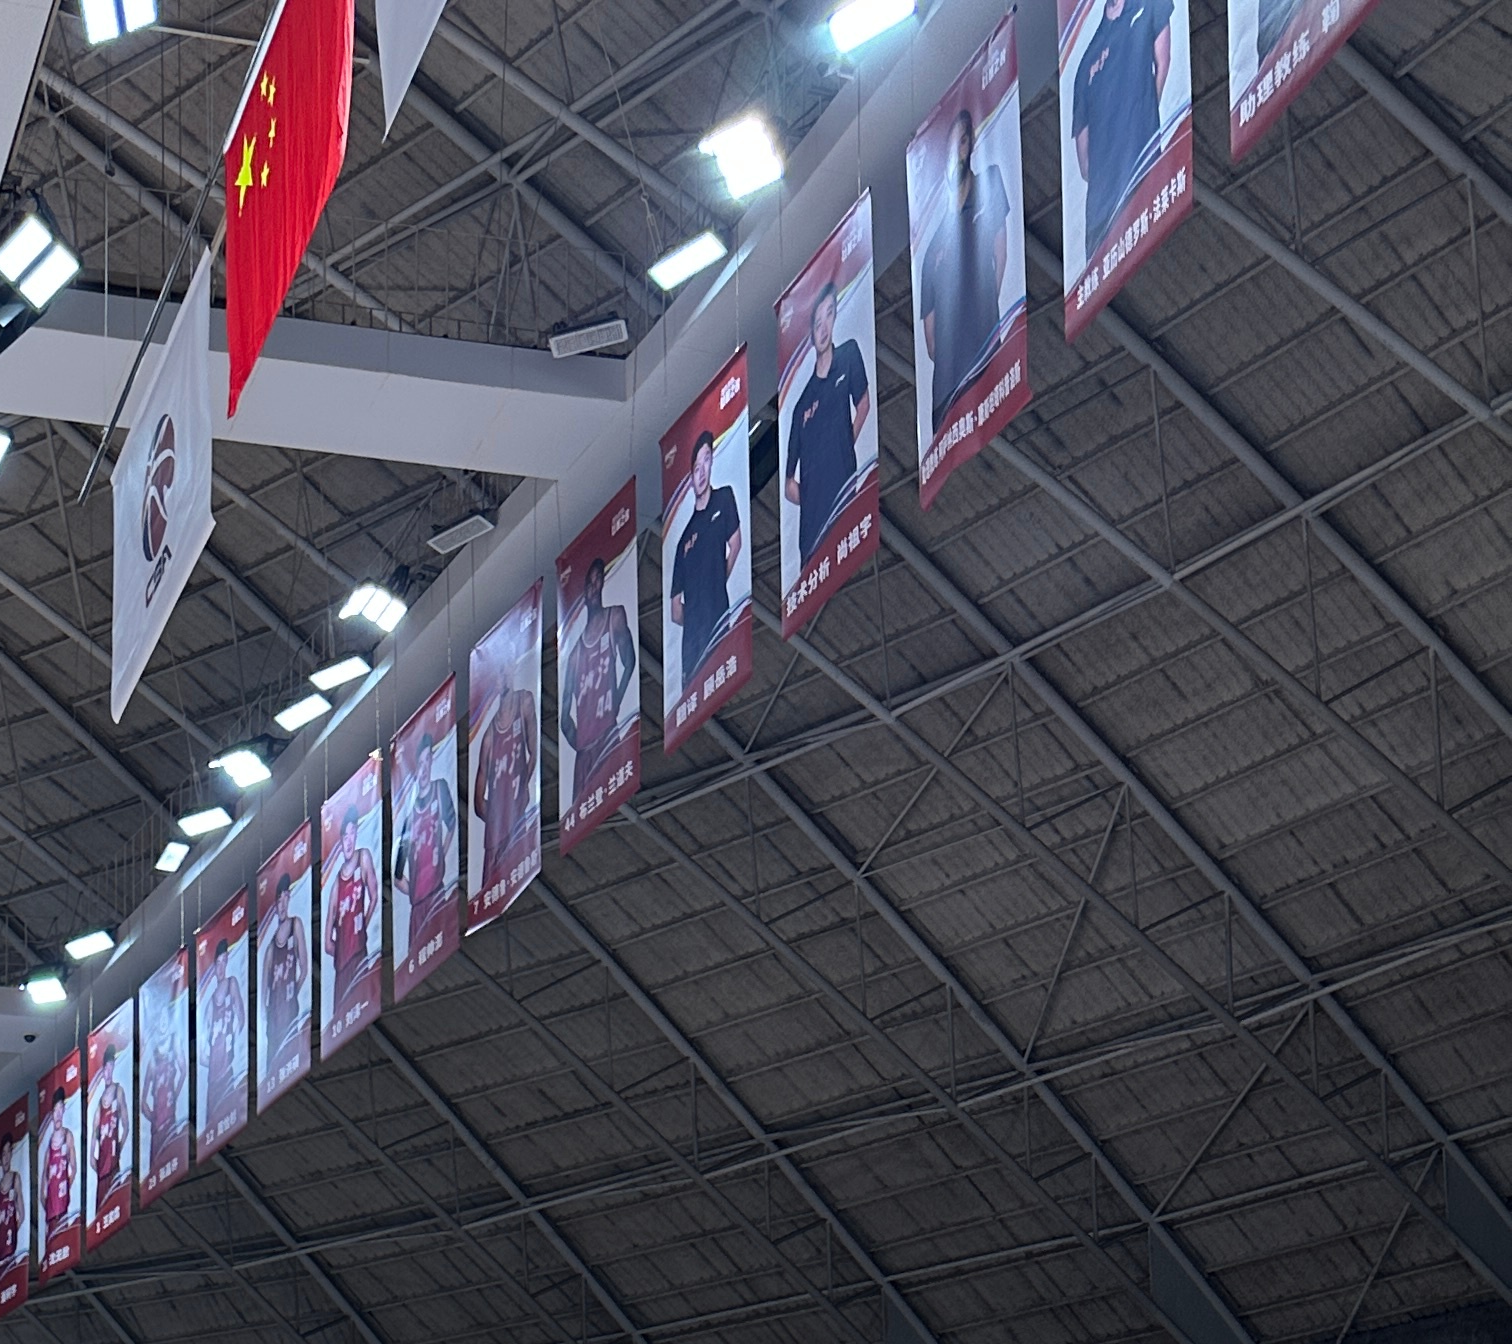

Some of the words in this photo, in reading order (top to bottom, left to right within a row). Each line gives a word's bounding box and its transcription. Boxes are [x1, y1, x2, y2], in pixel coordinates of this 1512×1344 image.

[1239, 28, 1310, 128] 助理教练
[145, 544, 173, 609] CBA
[786, 555, 832, 618] 技术分析
[596, 688, 613, 719] 44
[563, 812, 576, 833] 44
